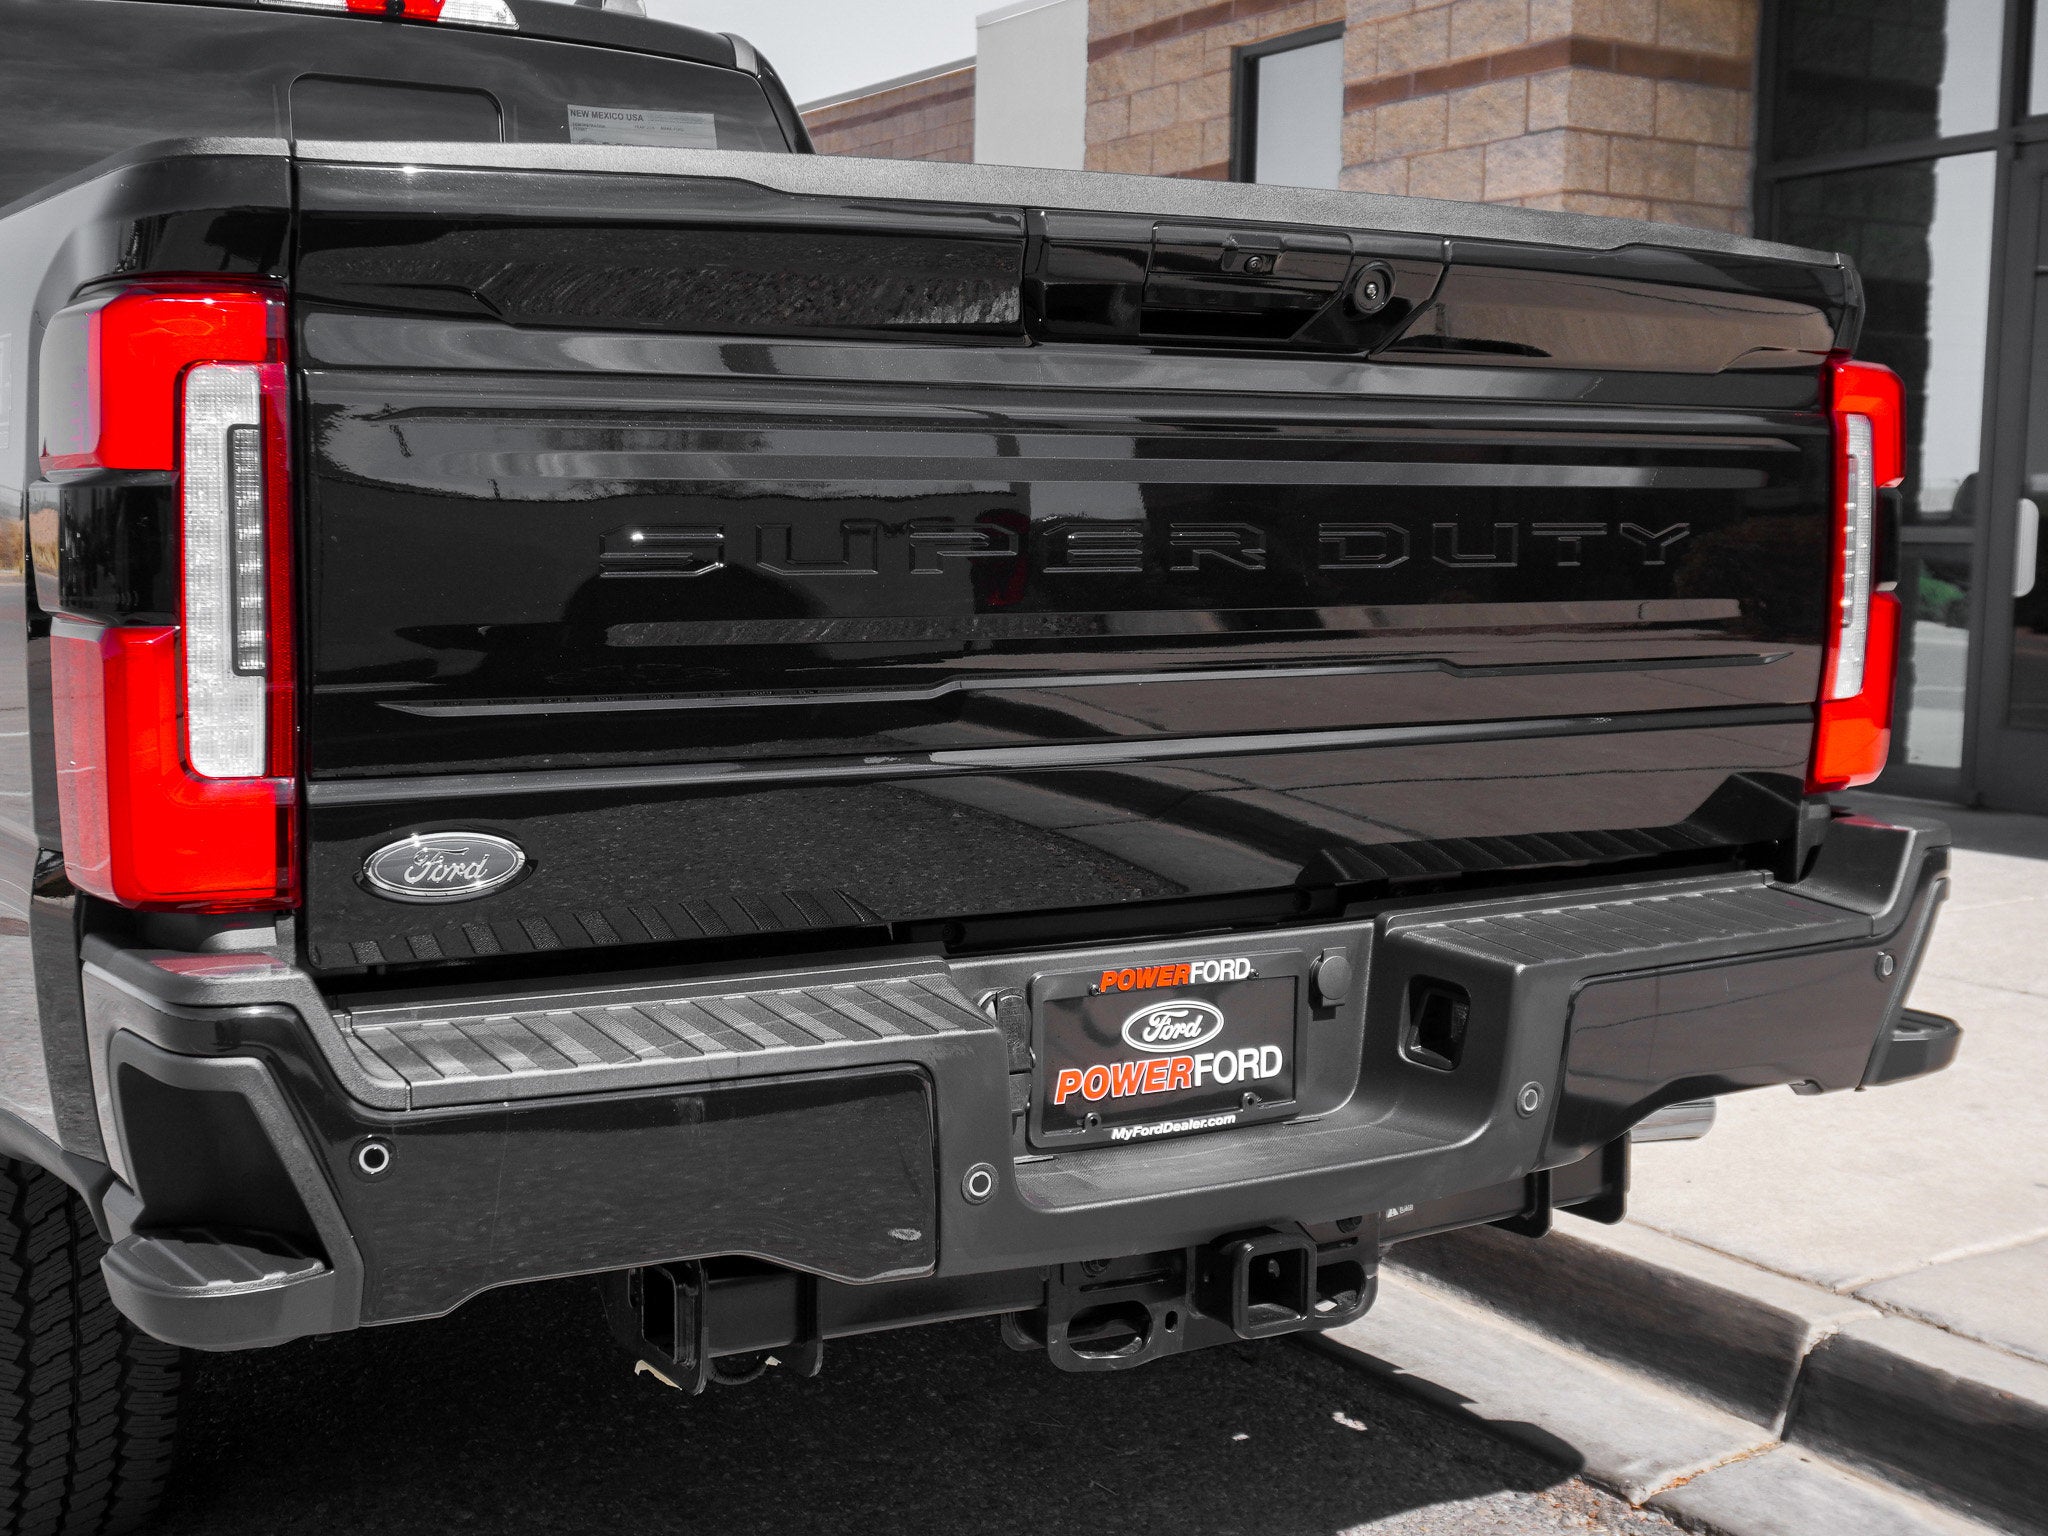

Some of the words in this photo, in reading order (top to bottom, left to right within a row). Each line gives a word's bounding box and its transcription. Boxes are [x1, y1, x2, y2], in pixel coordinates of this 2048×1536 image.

[570, 109, 590, 118] NEW
[591, 111, 624, 121] MEXICO
[626, 113, 644, 122] USA
[600, 522, 1266, 577] SUPER
[1319, 522, 1691, 568] DUTY
[403, 847, 491, 884] Ford
[1142, 1010, 1204, 1042] Ford
[1111, 1114, 1237, 1140] MyFordDealer.com
